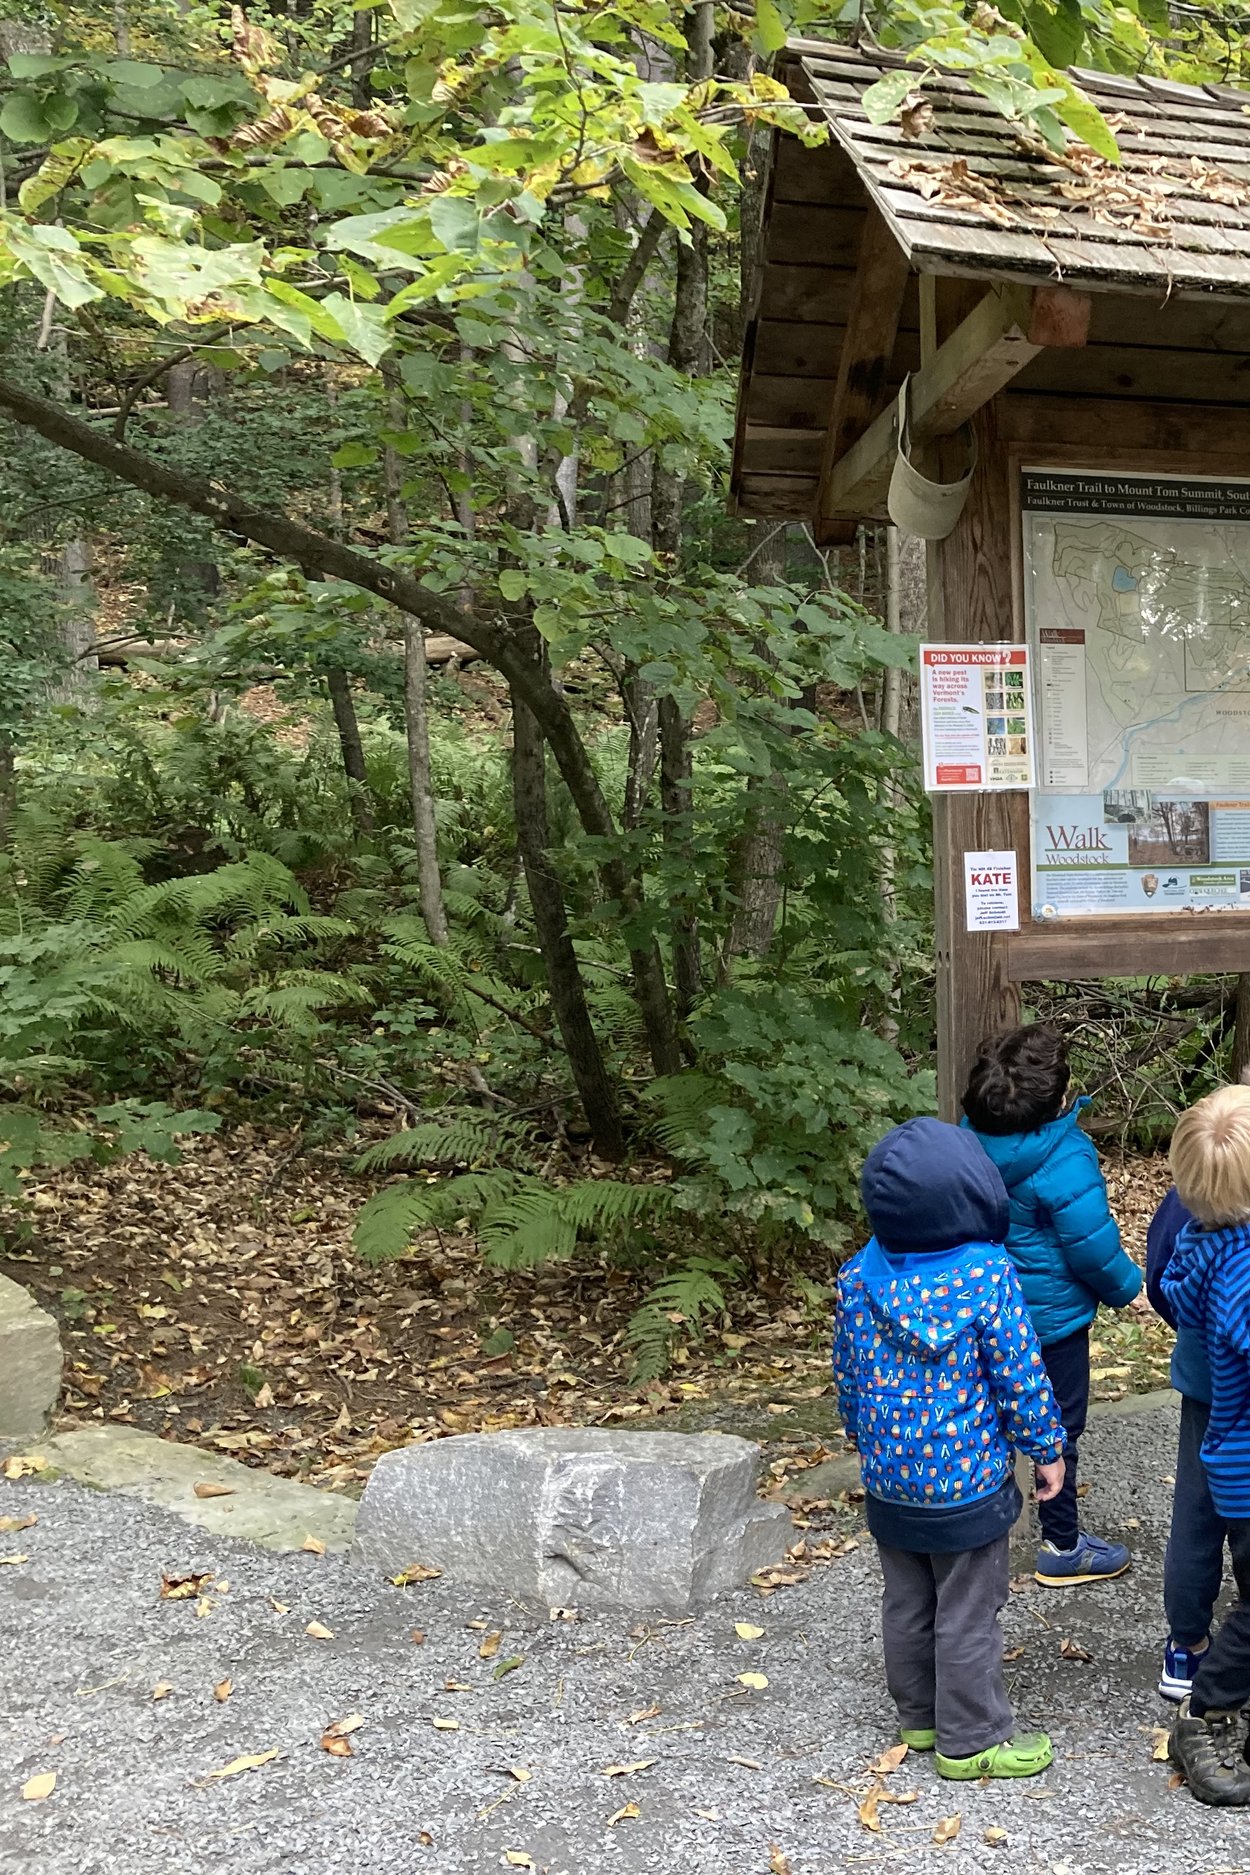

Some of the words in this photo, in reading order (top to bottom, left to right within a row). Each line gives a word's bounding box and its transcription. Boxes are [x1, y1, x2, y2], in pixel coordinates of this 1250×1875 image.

[1027, 478, 1075, 492] Faulkner
[1076, 482, 1102, 493] Trail
[1104, 485, 1116, 494] to
[1118, 484, 1153, 496] Mount
[1154, 486, 1179, 497] Tom
[1181, 487, 1225, 500] Summit,
[1027, 496, 1065, 506] Faulkner
[1066, 498, 1089, 507] Trust
[1100, 500, 1125, 509] Town
[1126, 501, 1136, 510] of
[1137, 502, 1184, 512] Woodstock,
[1186, 504, 1217, 515] Billings
[1218, 506, 1238, 514] Park
[930, 653, 948, 662] DID
[950, 654, 969, 662] YOU
[972, 650, 1012, 666] KNOW?
[1045, 825, 1109, 850] Walk
[1046, 852, 1110, 866] Woodstock
[970, 872, 1012, 886] KATE
